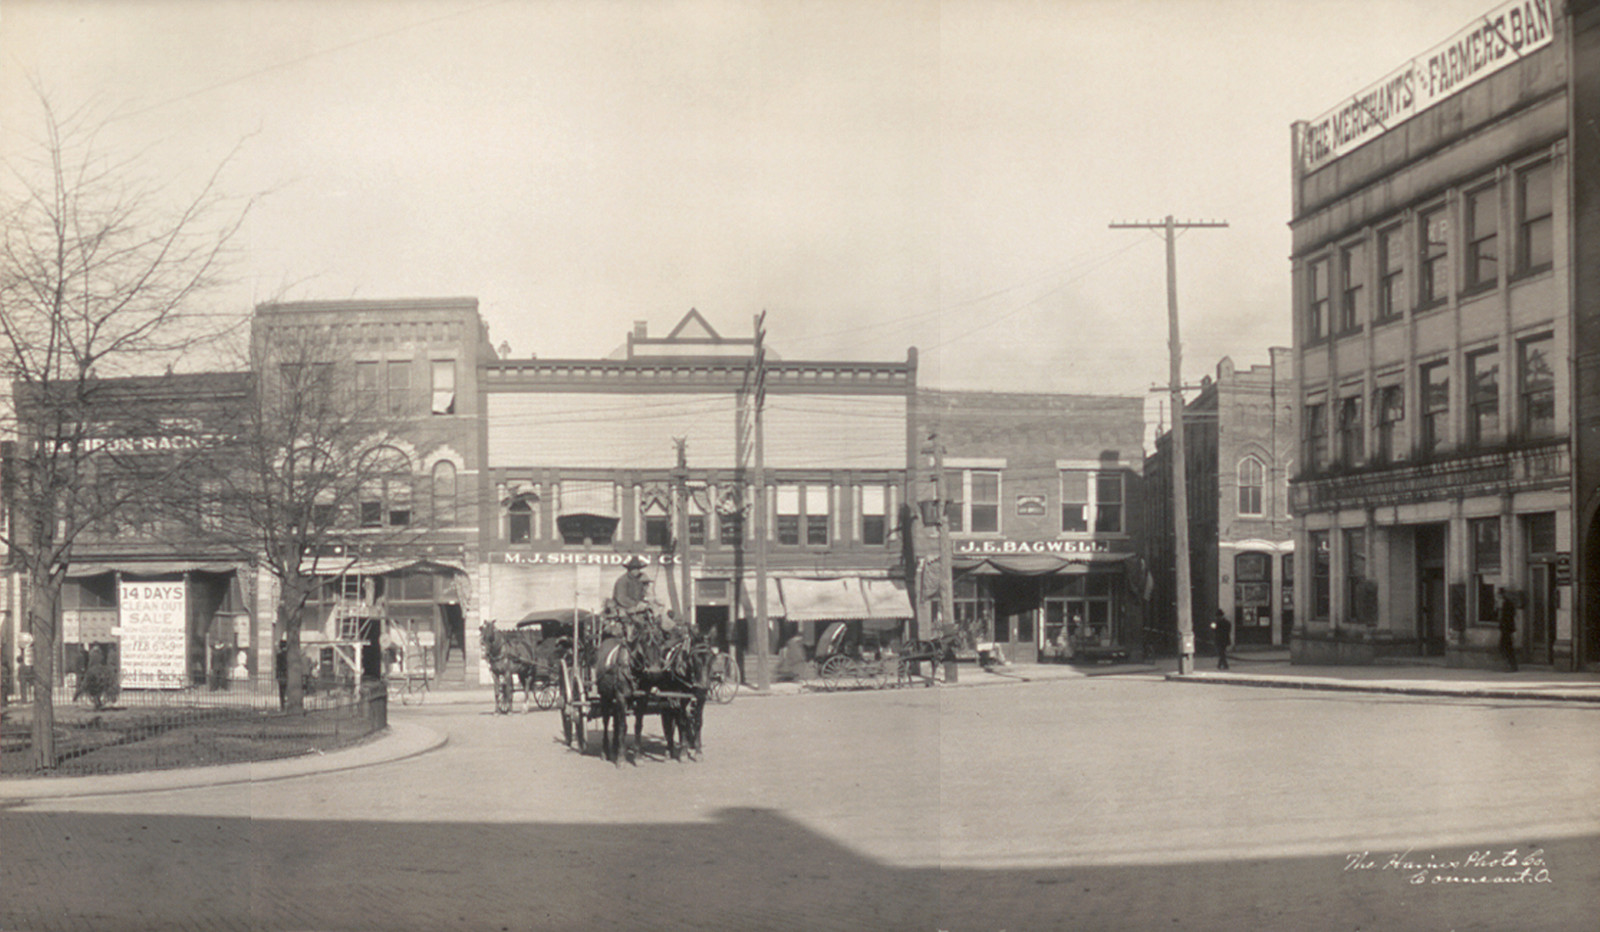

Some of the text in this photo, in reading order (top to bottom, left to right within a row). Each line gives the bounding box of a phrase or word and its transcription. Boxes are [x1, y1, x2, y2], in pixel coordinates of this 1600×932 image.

[1306, 120, 1329, 164] THE
[122, 586, 184, 600] 14 DAYS
[121, 600, 183, 612] CLEAN OUT
[129, 612, 173, 625] SALE
